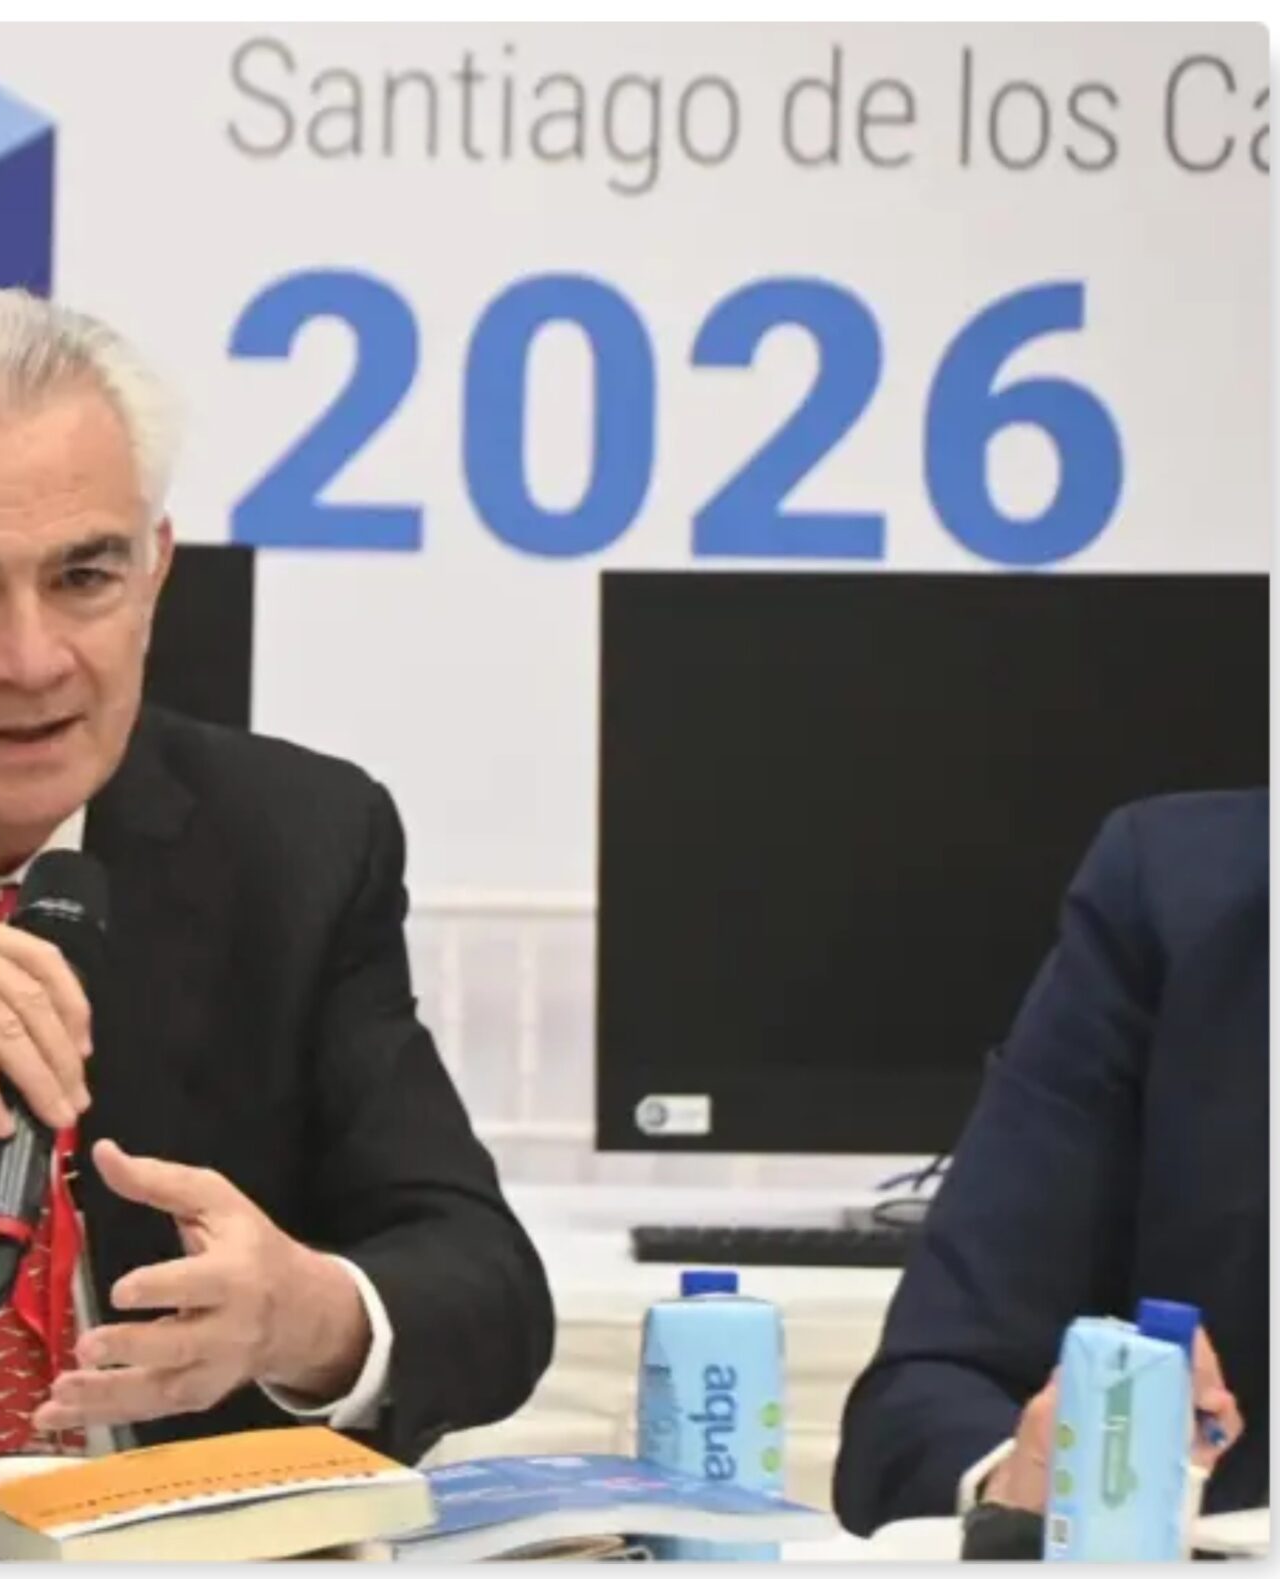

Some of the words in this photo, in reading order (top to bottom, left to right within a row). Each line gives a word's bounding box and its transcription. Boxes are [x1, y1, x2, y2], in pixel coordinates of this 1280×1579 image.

[227, 38, 741, 196] Santiago
[781, 43, 918, 169] de
[958, 45, 1121, 174] los
[227, 267, 1124, 569] 2026
[688, 1364, 738, 1481] aqua
